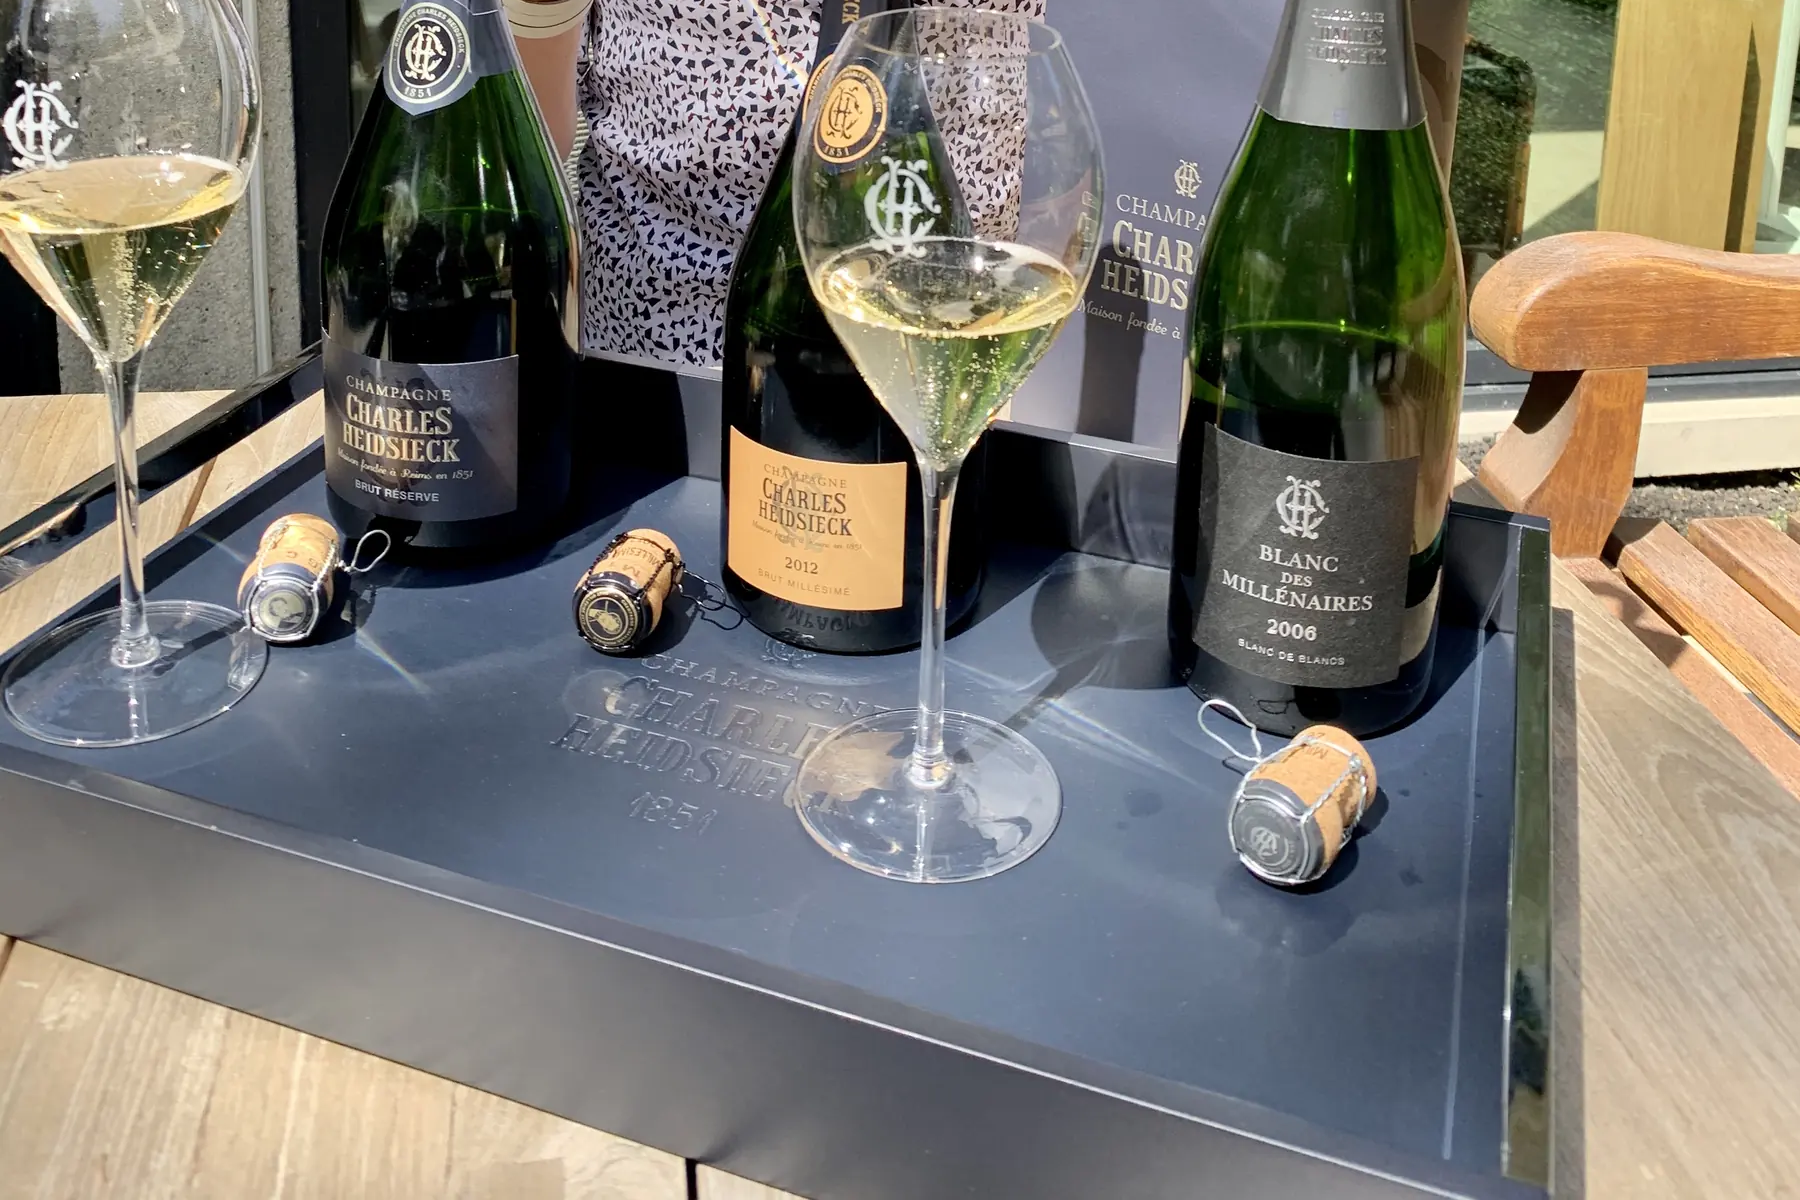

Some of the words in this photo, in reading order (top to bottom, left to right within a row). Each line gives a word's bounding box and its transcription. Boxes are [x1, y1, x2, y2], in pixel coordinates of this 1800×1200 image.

[404, 86, 432, 98] 1851
[1115, 193, 1207, 232] CHAMPA
[1112, 219, 1195, 276] CHAR
[1100, 259, 1190, 311] HEIDS
[1077, 297, 1123, 323] Maison
[1126, 310, 1168, 336] fondée
[1171, 324, 1182, 340] à
[345, 374, 452, 402] CHAMPAGNE
[345, 392, 453, 436] CHARLES
[342, 420, 461, 464] HEIDSIECK
[355, 478, 382, 496] BRUT
[384, 487, 440, 502] RÉSERVE
[435, 471, 448, 480] en
[451, 469, 474, 480] 1851
[763, 462, 848, 489] CHAMPAGNE
[762, 477, 847, 515] CHARLES
[758, 499, 853, 537] HEIDSIECK
[784, 556, 819, 575] 2012
[1258, 544, 1340, 573] BLANC
[757, 567, 784, 584] BRUT
[786, 578, 851, 596] MILLÉSIMÉ
[1220, 569, 1374, 612] MILLÉNAIRES
[1279, 571, 1313, 588] DES
[1266, 618, 1318, 642] 2006
[1237, 637, 1274, 657] BLANC
[1278, 649, 1295, 663] DE
[1298, 654, 1346, 666] BLANCS
[604, 675, 838, 761] CHARLE
[549, 711, 808, 808] HEIDSIE
[628, 790, 719, 836] 1851
